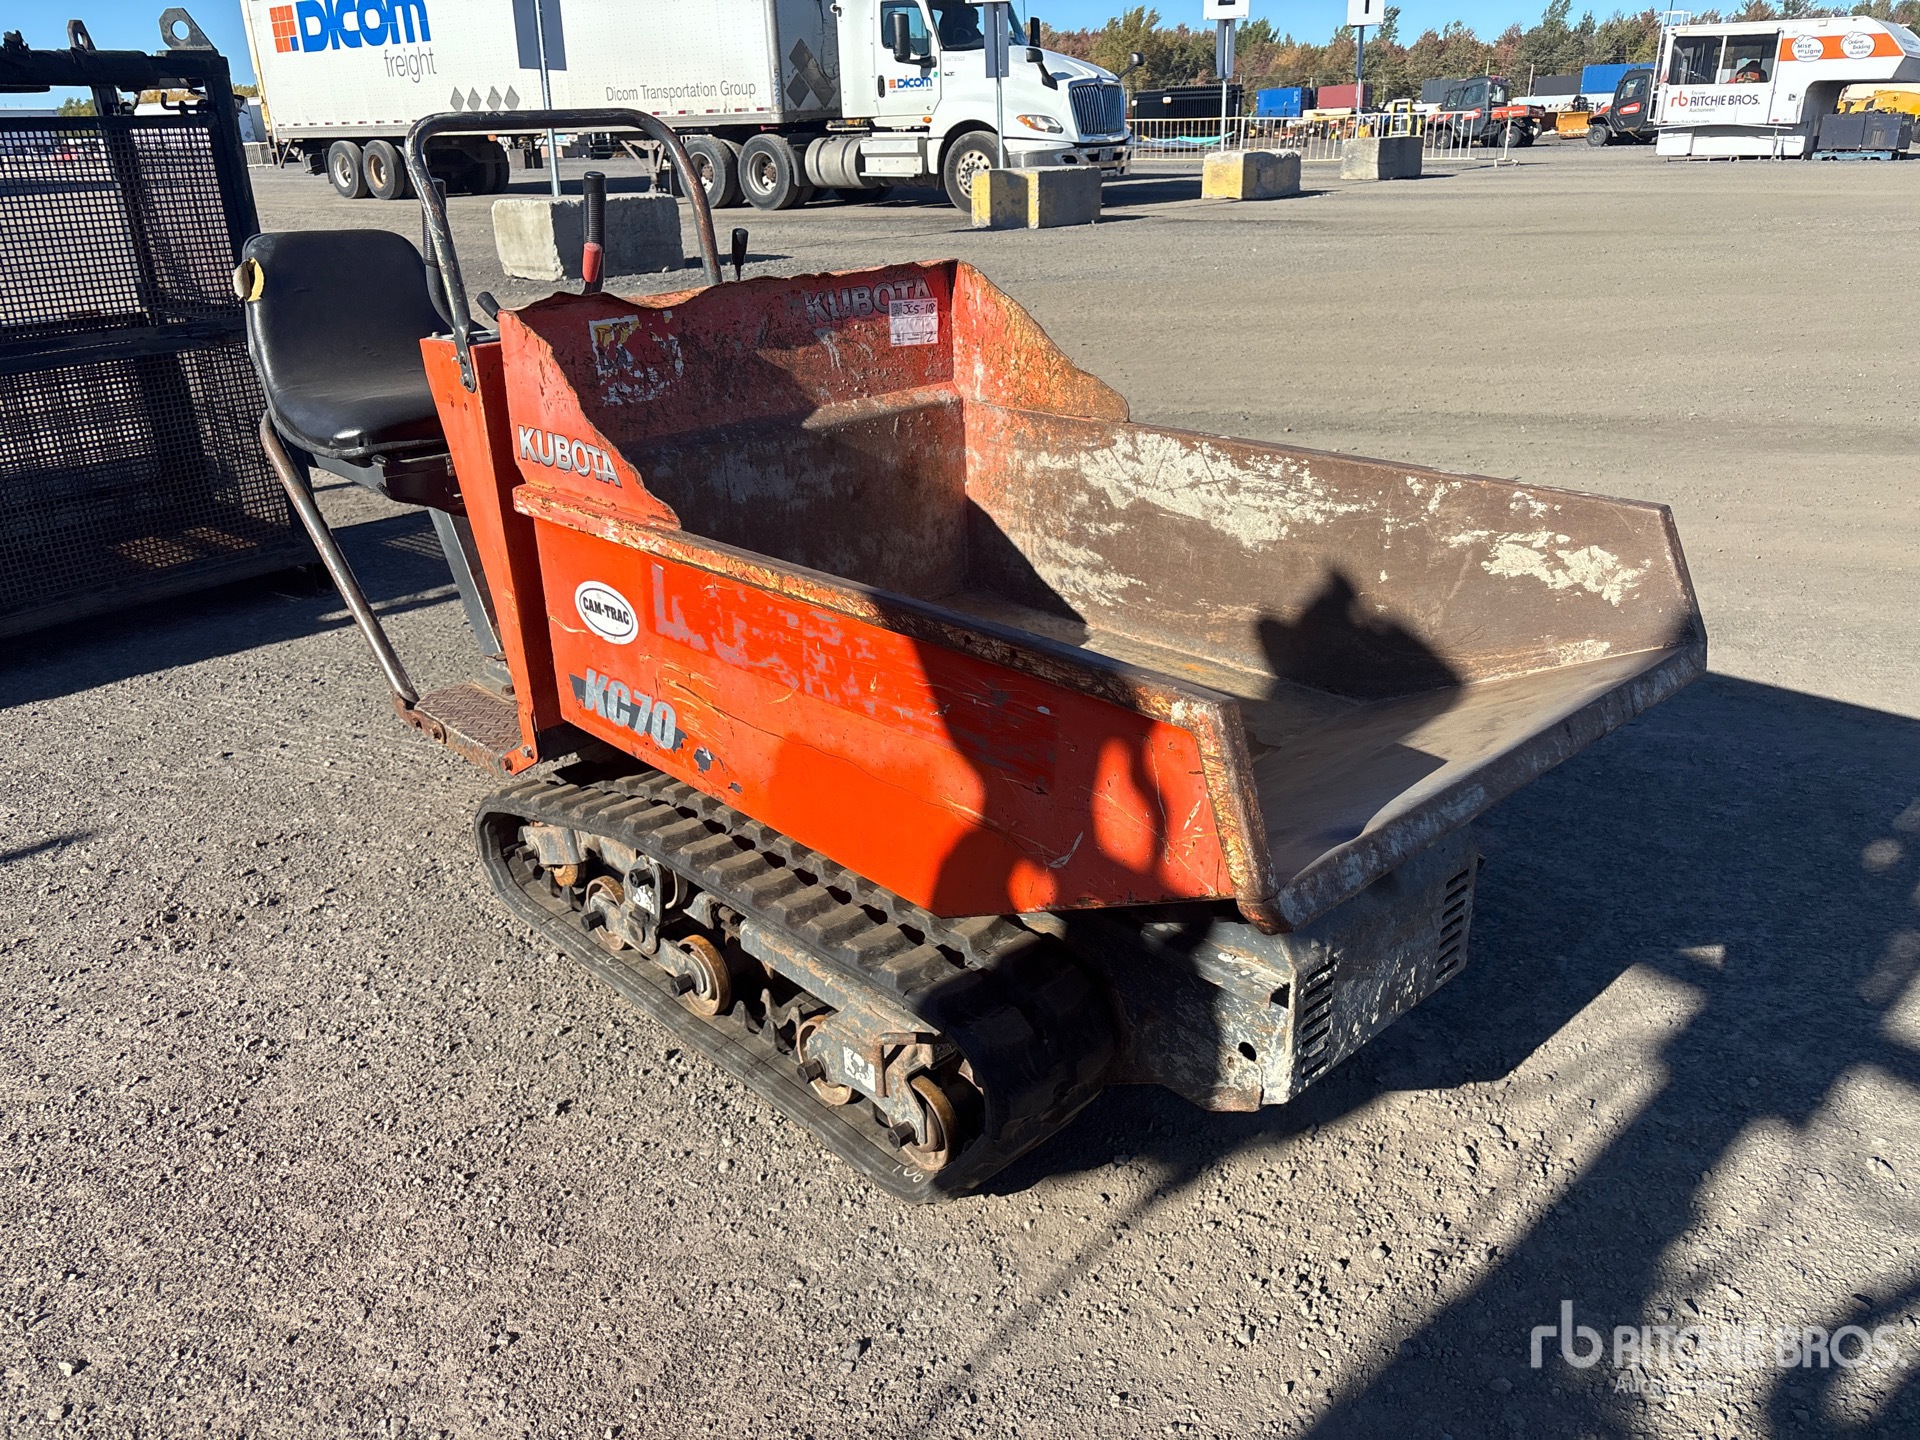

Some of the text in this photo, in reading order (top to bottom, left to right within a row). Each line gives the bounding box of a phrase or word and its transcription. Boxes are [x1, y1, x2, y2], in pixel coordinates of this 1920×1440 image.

[384, 46, 437, 83] freight
[606, 79, 757, 103] Dicom Transportation Group
[773, 68, 782, 107] 5424
[1671, 90, 1761, 107] rb RITCHIE BROS.
[801, 277, 932, 324] KUBOTA
[518, 425, 622, 488] KUBOTA
[583, 596, 630, 626] CAM-TRAC
[583, 667, 677, 750] KC70
